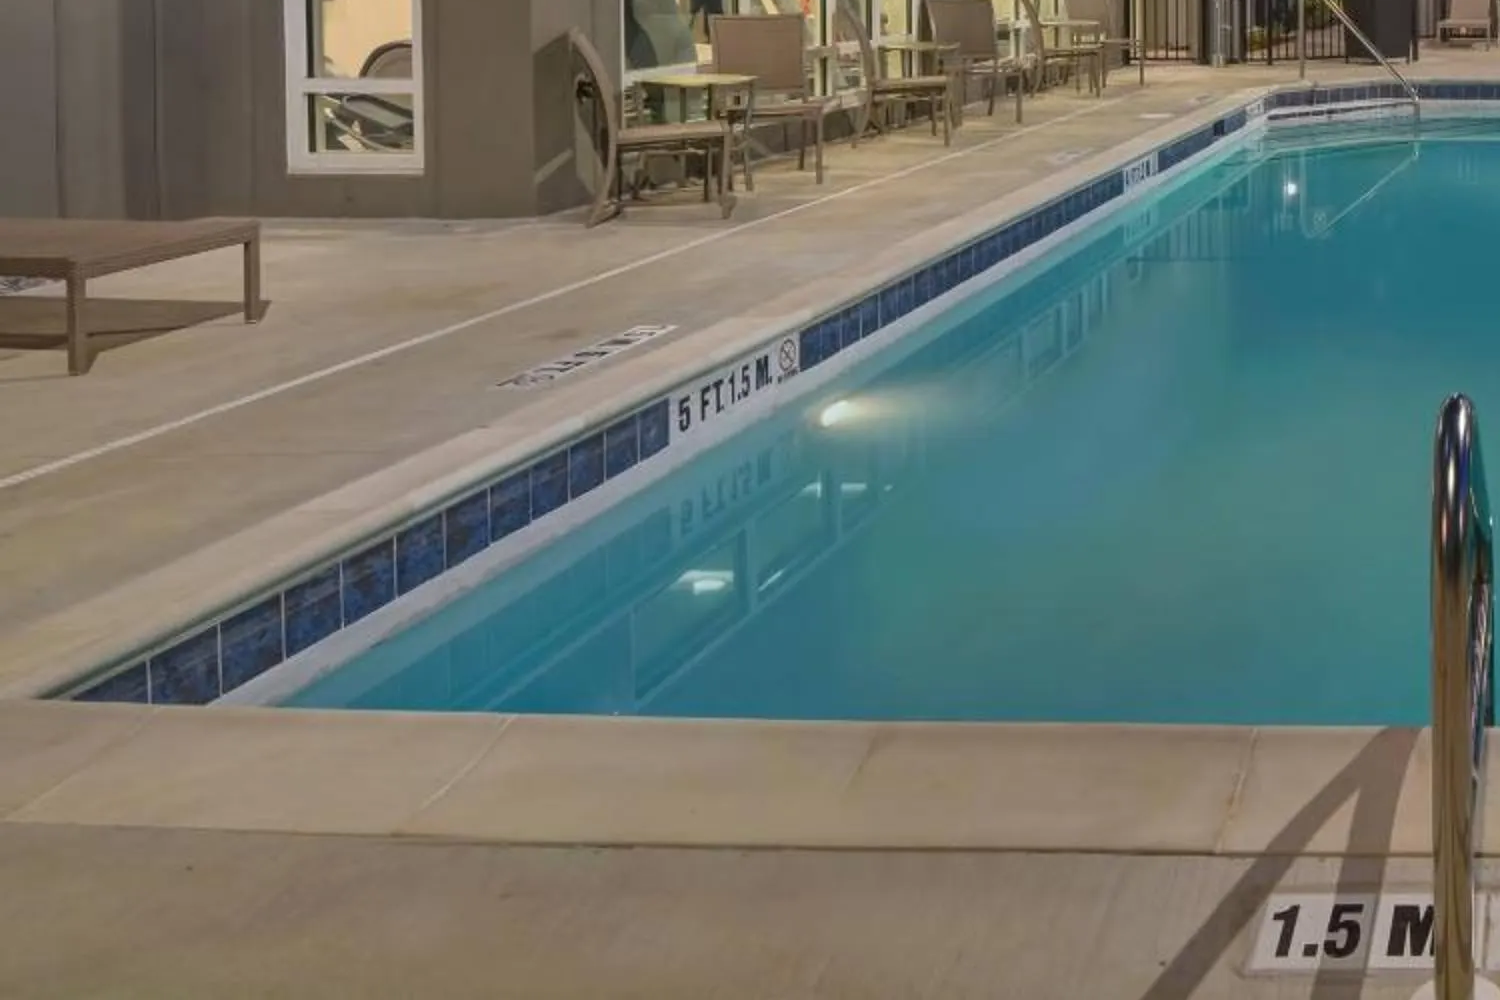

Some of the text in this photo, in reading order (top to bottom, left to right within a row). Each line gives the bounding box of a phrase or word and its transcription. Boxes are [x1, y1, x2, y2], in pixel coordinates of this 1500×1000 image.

[679, 395, 691, 432] 5
[729, 364, 750, 404] 1.5
[1273, 904, 1364, 958] 1.5
